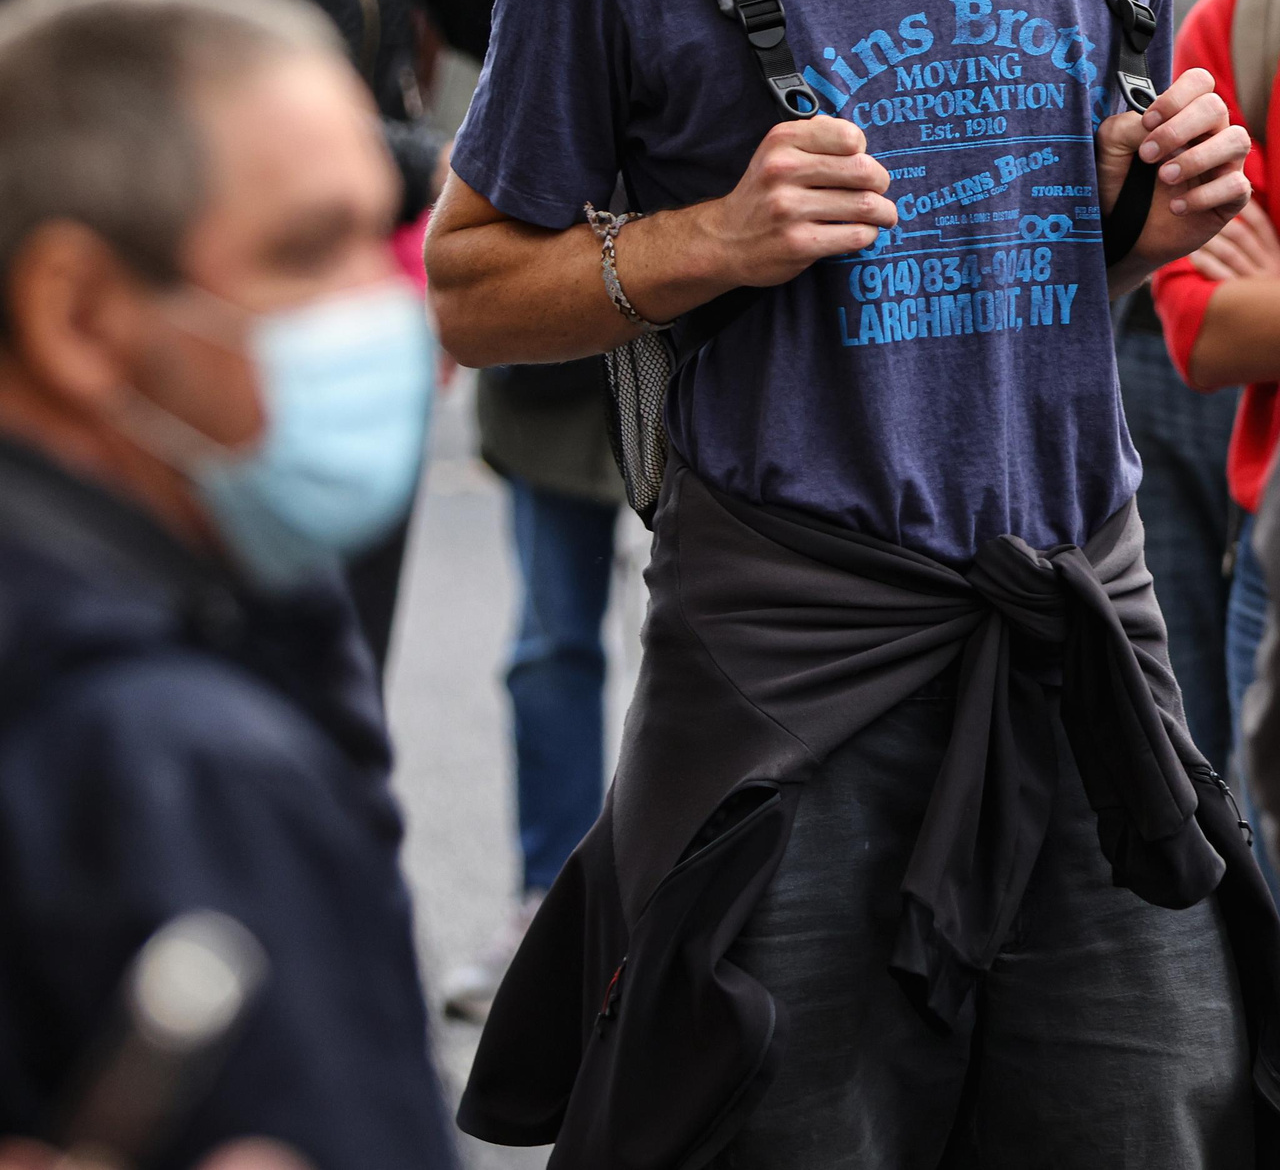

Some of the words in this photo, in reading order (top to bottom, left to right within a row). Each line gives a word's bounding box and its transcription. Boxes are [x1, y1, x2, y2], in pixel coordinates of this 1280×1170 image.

[797, 11, 935, 117] lins
[894, 52, 1022, 93] MOVING
[852, 82, 1066, 130] CORPORATION
[919, 123, 960, 142] Est.
[965, 116, 1007, 137] 1910
[887, 165, 927, 181] OVING
[1031, 185, 1092, 197] STORAGE
[935, 214, 960, 227] LOCAL
[1030, 283, 1079, 327] NY
